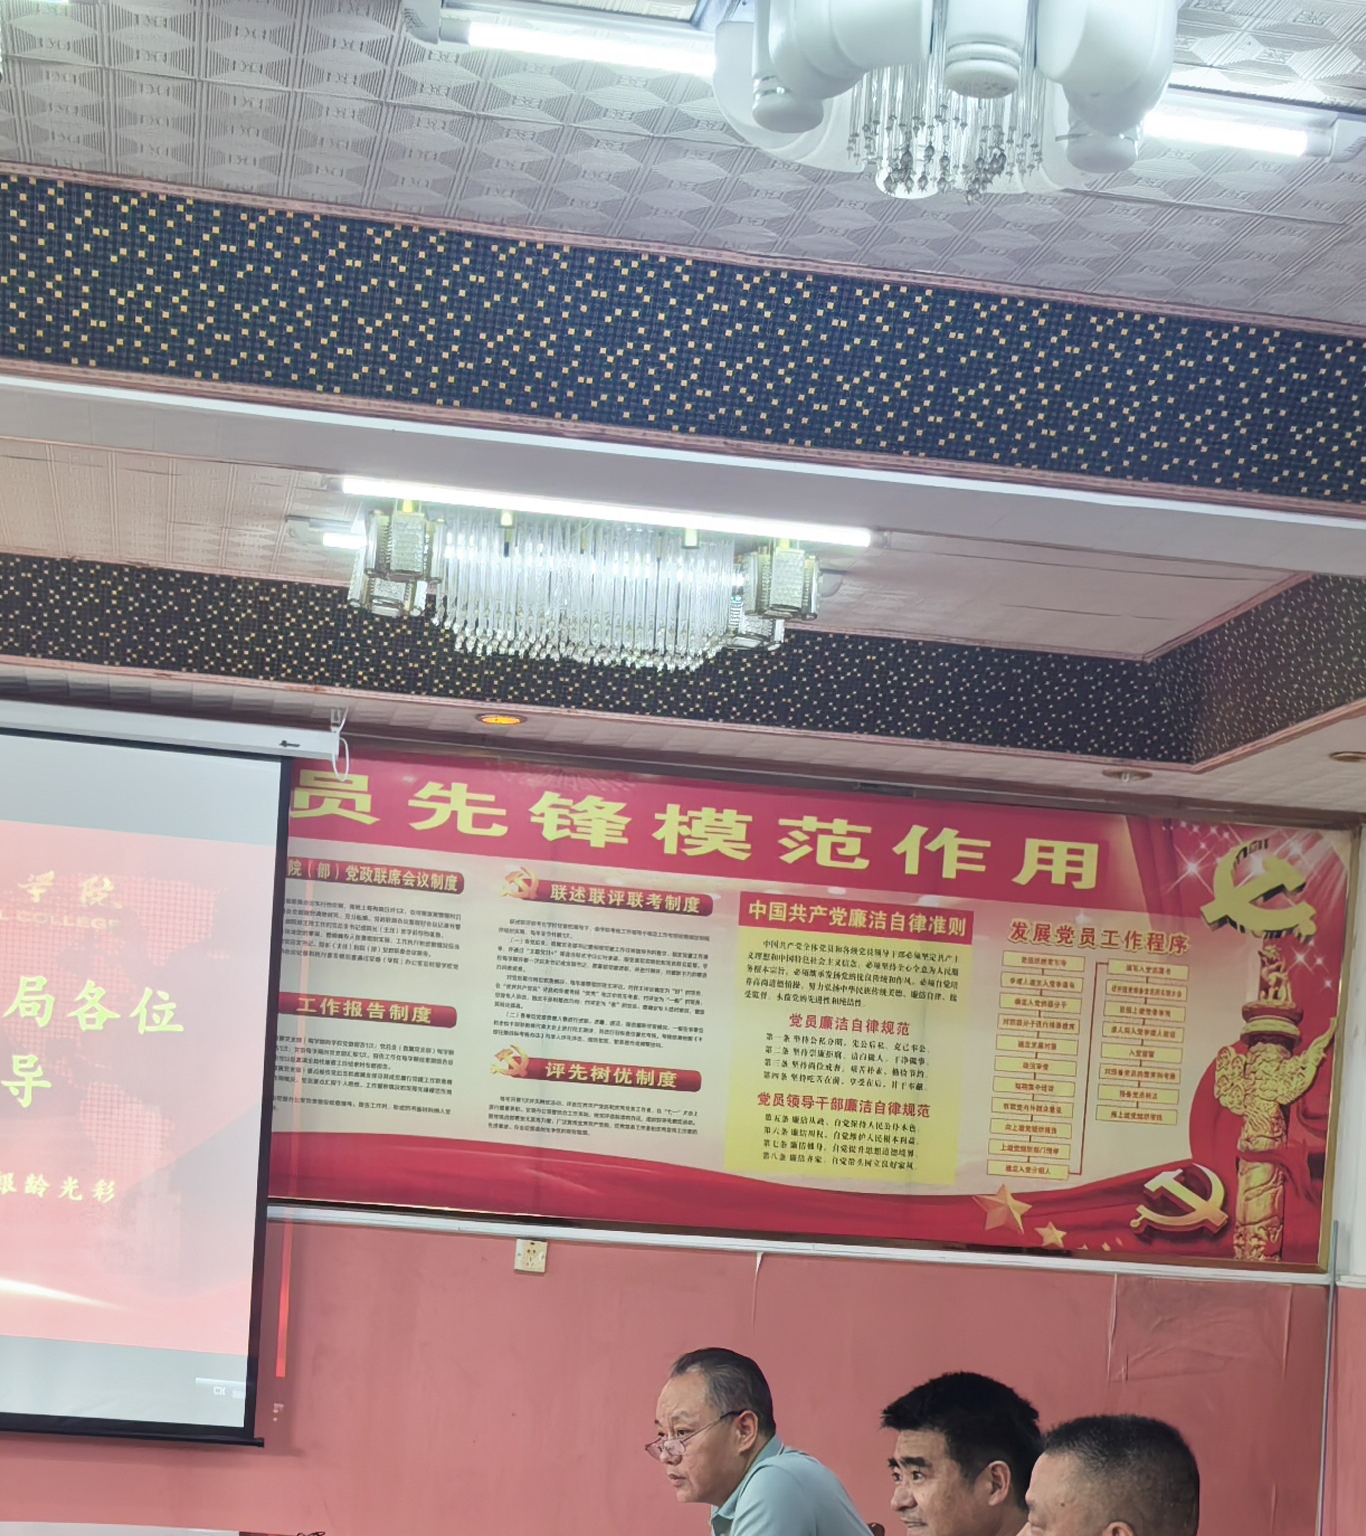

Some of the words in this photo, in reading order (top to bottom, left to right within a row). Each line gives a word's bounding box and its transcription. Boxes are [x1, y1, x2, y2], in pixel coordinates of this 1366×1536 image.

[289, 769, 1099, 889] 员先锋模范作用
[550, 884, 700, 914] 联述联评联考制度
[749, 900, 966, 937] 中国共产党廉洁自律准则
[1009, 921, 1189, 954] 发展党员工作程序
[297, 997, 433, 1024] 工作报告制度
[789, 1013, 910, 1036] 党员廉洁自律规范
[546, 1061, 677, 1088] 评先树优制度
[757, 1092, 931, 1118] 党员领导干部廉洁自律规范
